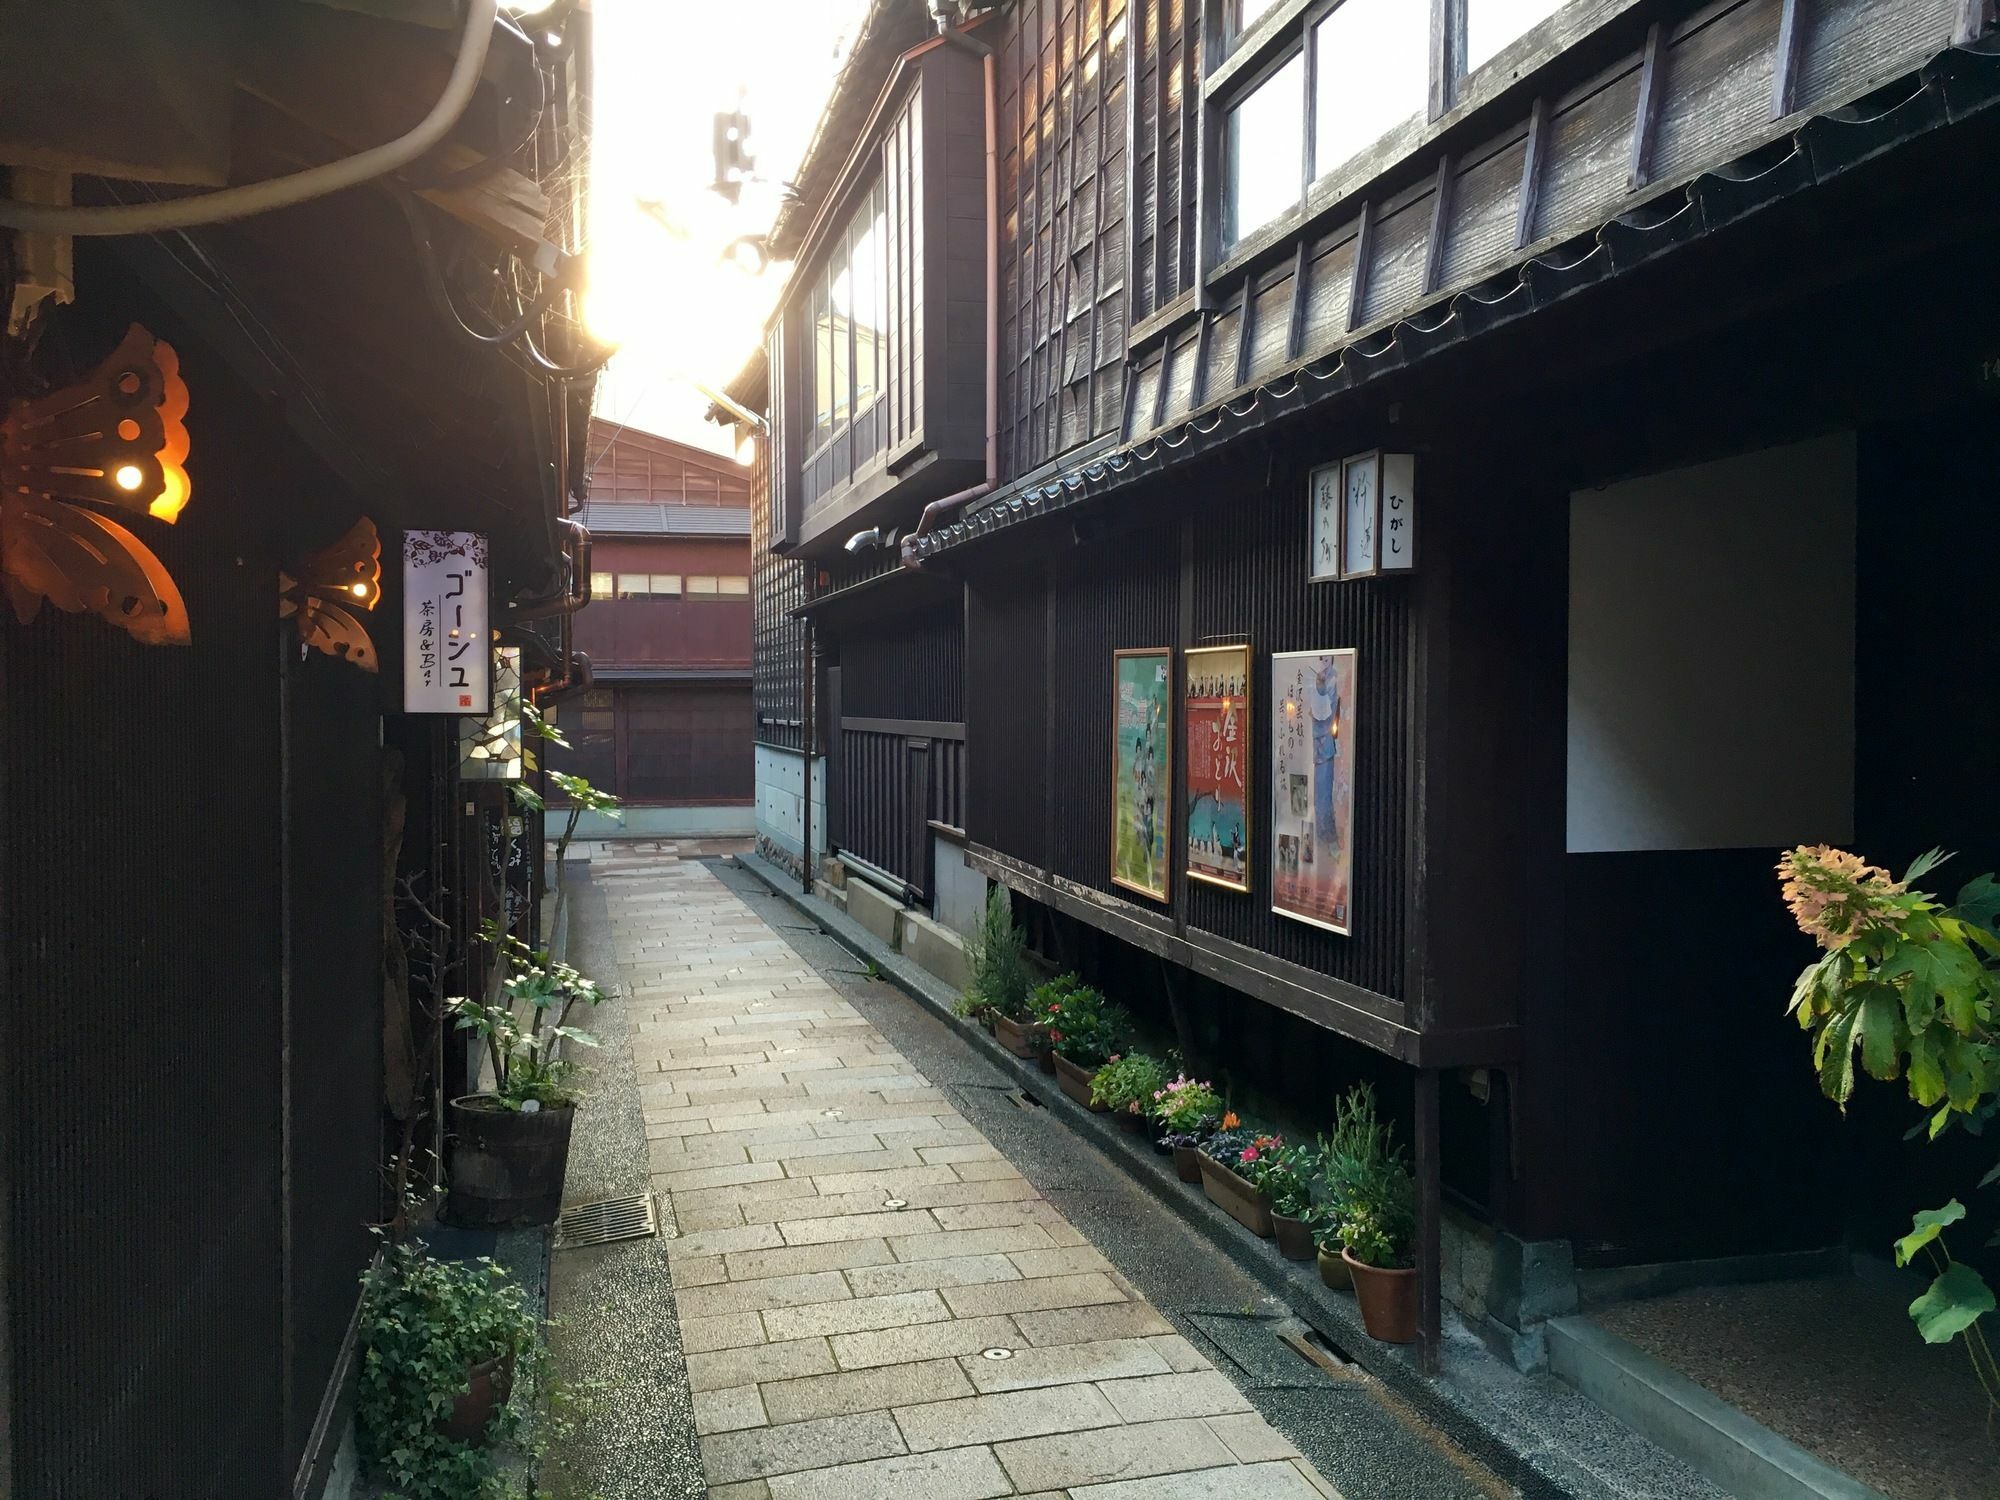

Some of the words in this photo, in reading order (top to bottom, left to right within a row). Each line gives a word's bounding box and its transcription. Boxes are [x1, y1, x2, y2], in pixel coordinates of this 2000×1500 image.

[1389, 495, 1404, 554] ひがし
[446, 569, 473, 688] ゴーシュ
[1211, 713, 1224, 814] おどり
[1222, 701, 1243, 788] 金沢
